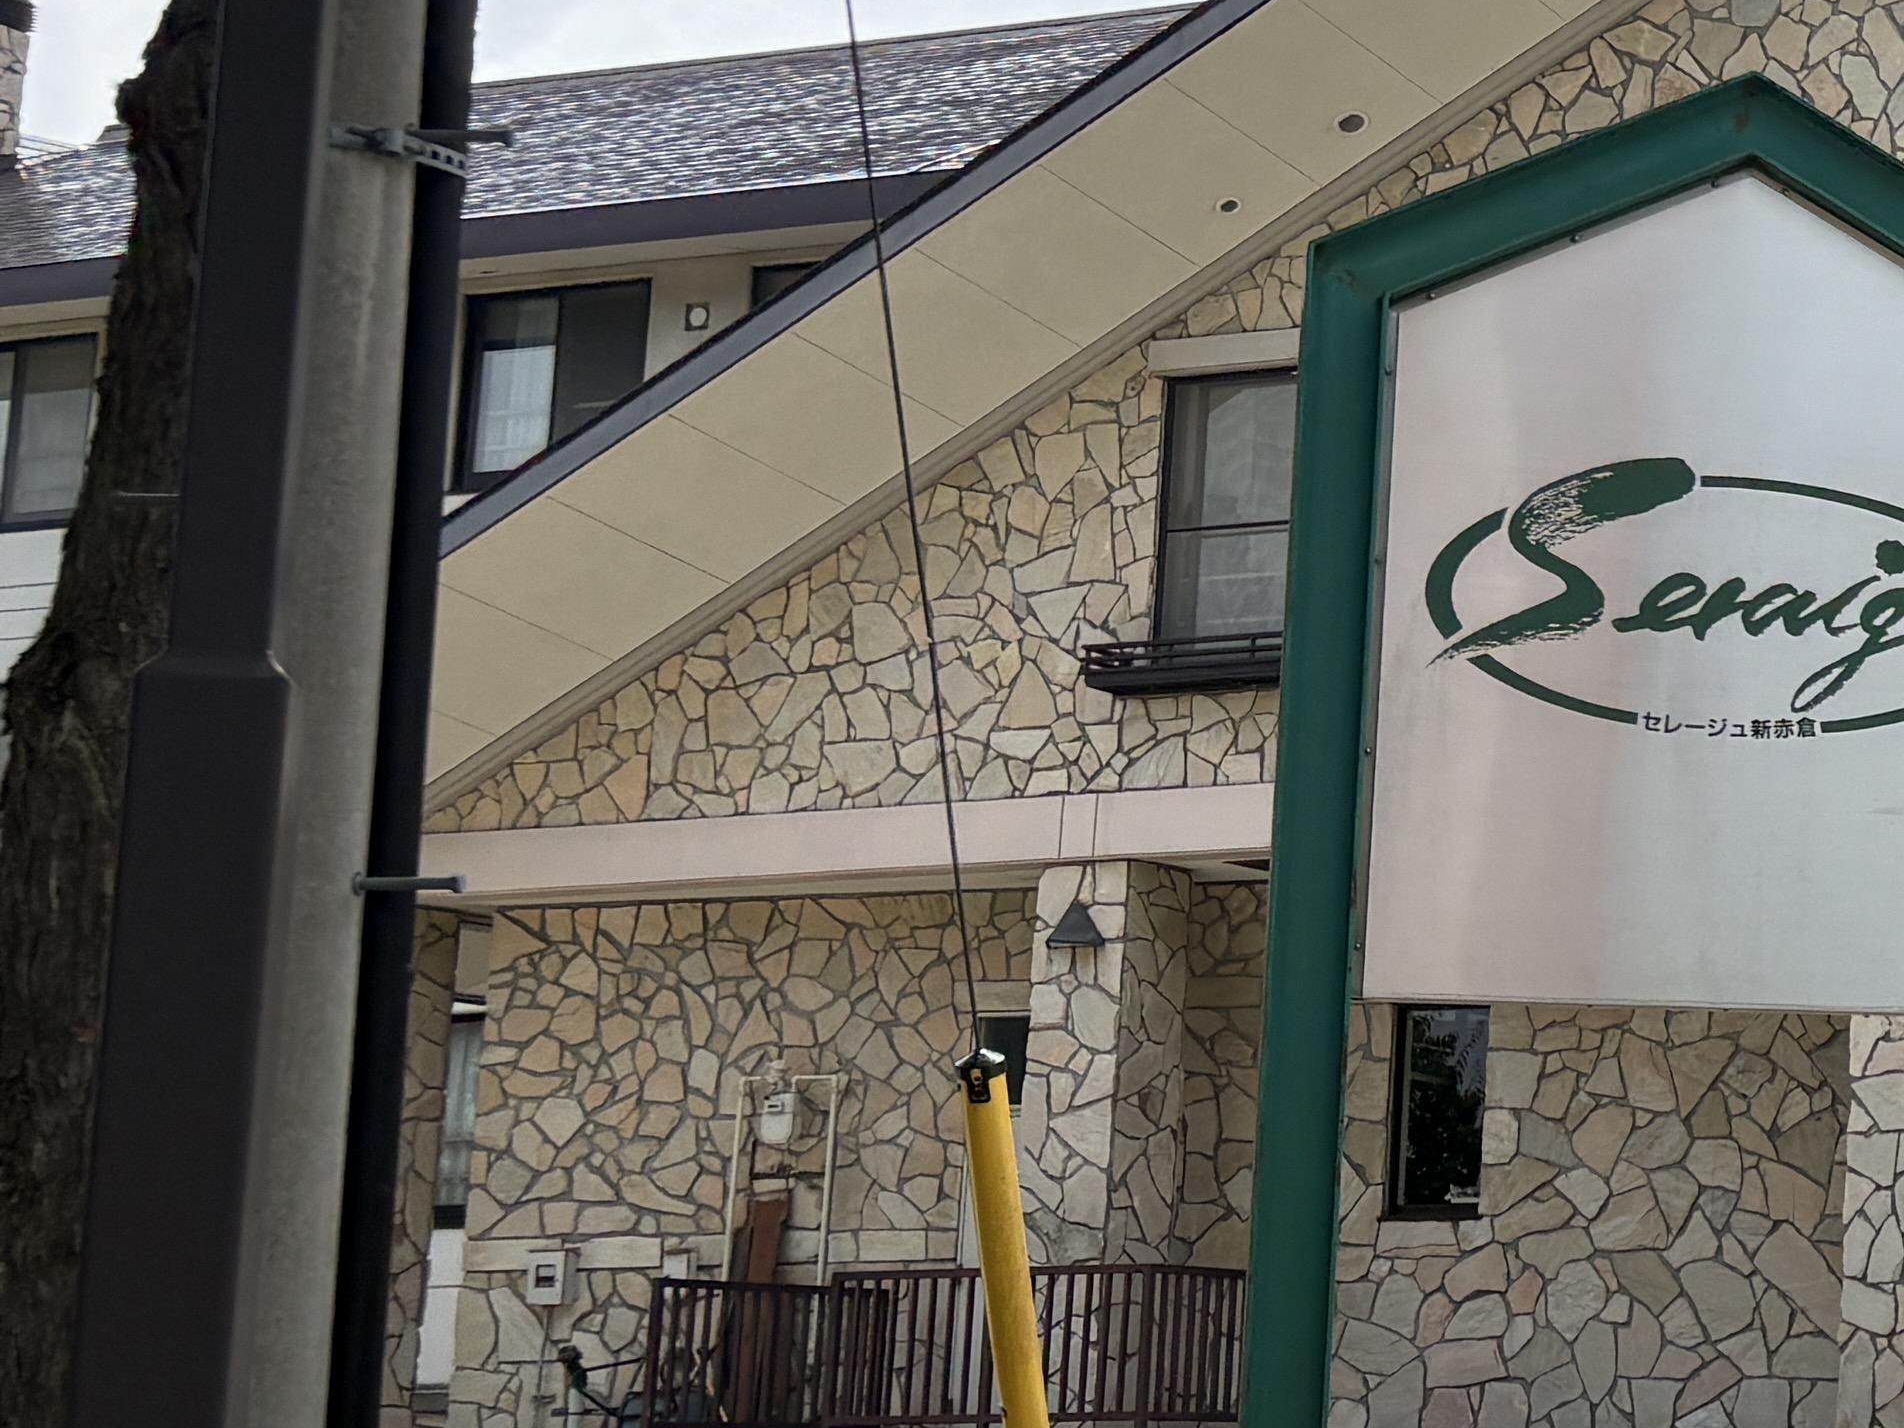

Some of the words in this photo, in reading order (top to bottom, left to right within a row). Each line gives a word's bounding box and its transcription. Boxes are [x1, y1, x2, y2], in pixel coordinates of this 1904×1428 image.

[1642, 711, 1818, 739] セレージュ新赤倉
